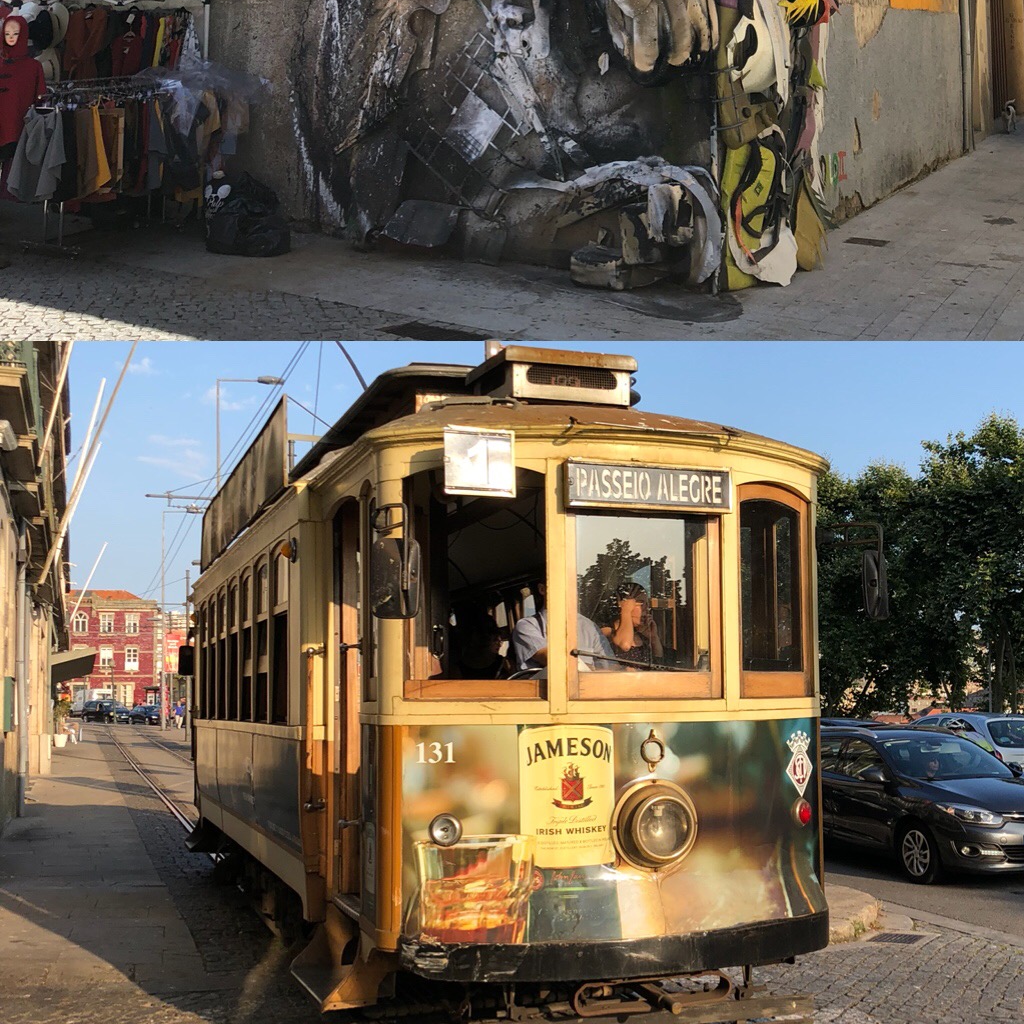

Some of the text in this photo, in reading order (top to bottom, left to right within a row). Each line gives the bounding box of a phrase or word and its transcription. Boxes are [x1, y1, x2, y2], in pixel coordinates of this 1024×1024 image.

[576, 467, 722, 504] PASSEIO ALEGRE
[415, 741, 456, 764] 131
[526, 737, 612, 767] JAMESON
[535, 825, 607, 836] IRISH WHISKEY
